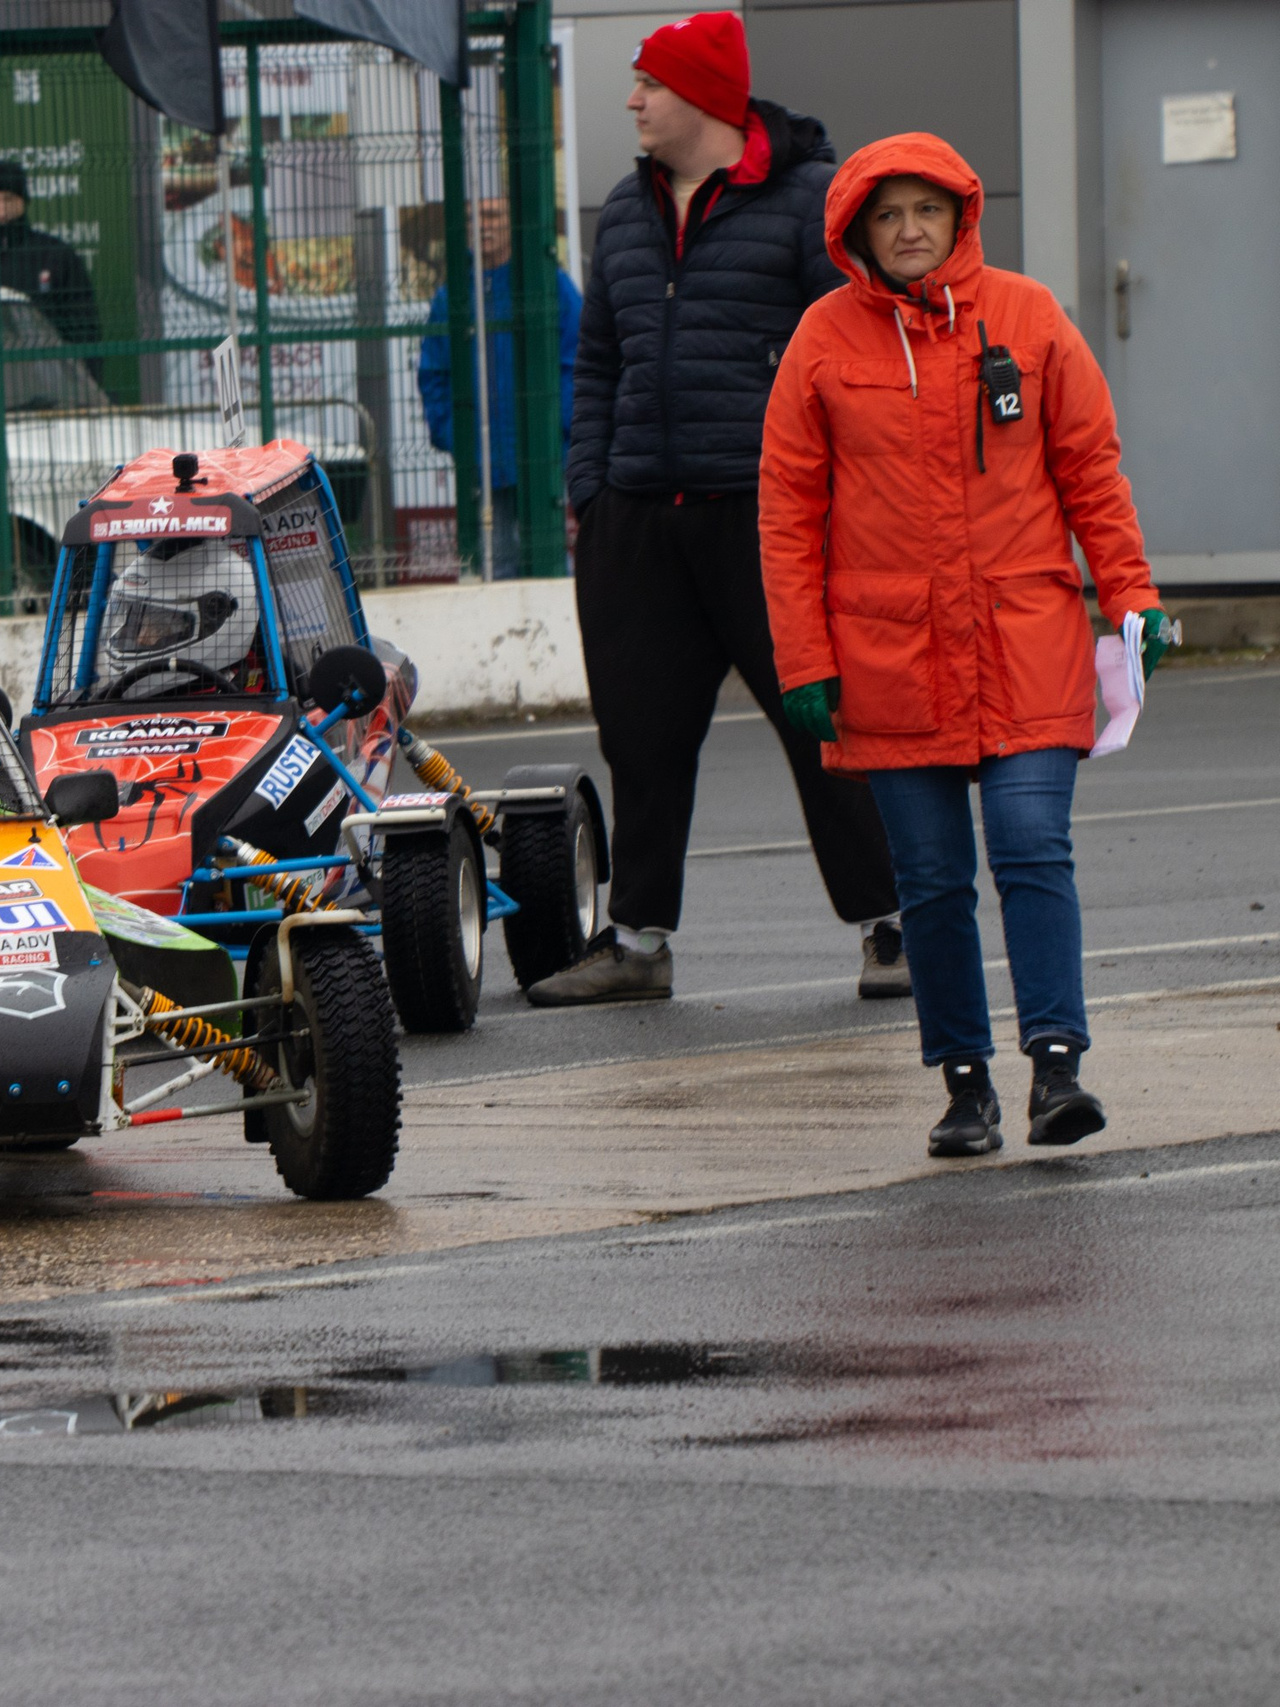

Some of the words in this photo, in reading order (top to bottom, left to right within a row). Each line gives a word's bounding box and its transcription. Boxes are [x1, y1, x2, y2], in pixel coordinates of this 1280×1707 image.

[995, 392, 1021, 417] 12
[88, 725, 216, 742] KRAMAR
[97, 743, 190, 757] КРАМАР
[260, 739, 320, 804] RUSTA
[18, 934, 51, 951] ADV
[3, 952, 46, 965] RACING
